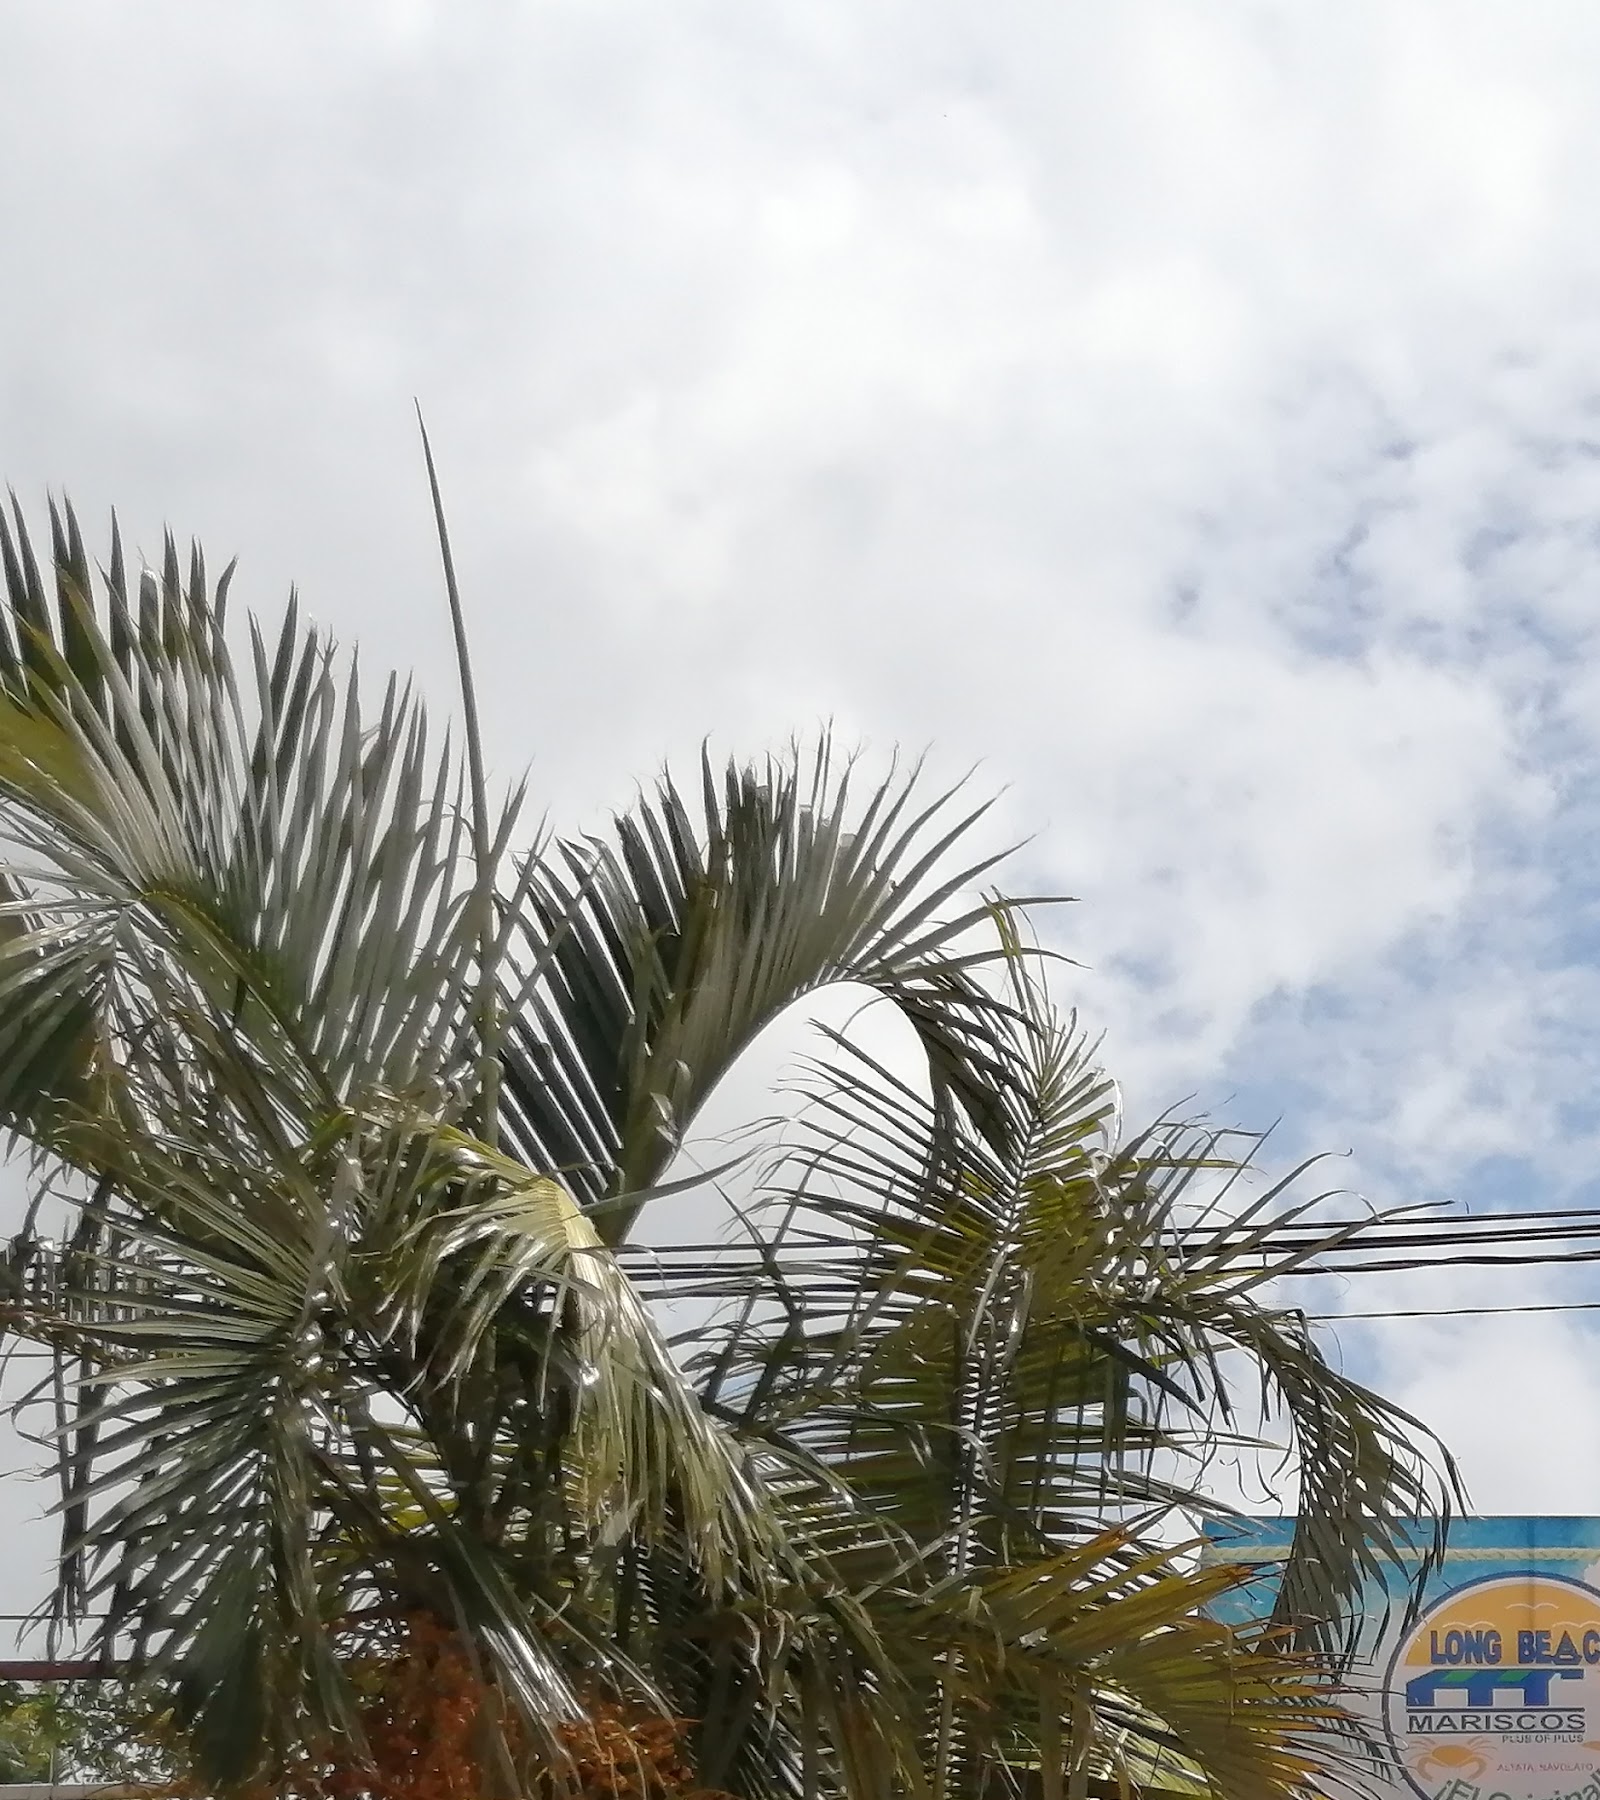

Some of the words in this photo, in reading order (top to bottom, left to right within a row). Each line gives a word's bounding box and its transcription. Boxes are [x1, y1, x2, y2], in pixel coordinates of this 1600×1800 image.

[1430, 1630, 1502, 1665] LONG
[1408, 1714, 1586, 1731] MARISCOS
[1502, 1734, 1531, 1744] PLUS
[1535, 1734, 1550, 1743] OF
[1553, 1733, 1584, 1743] PLUS
